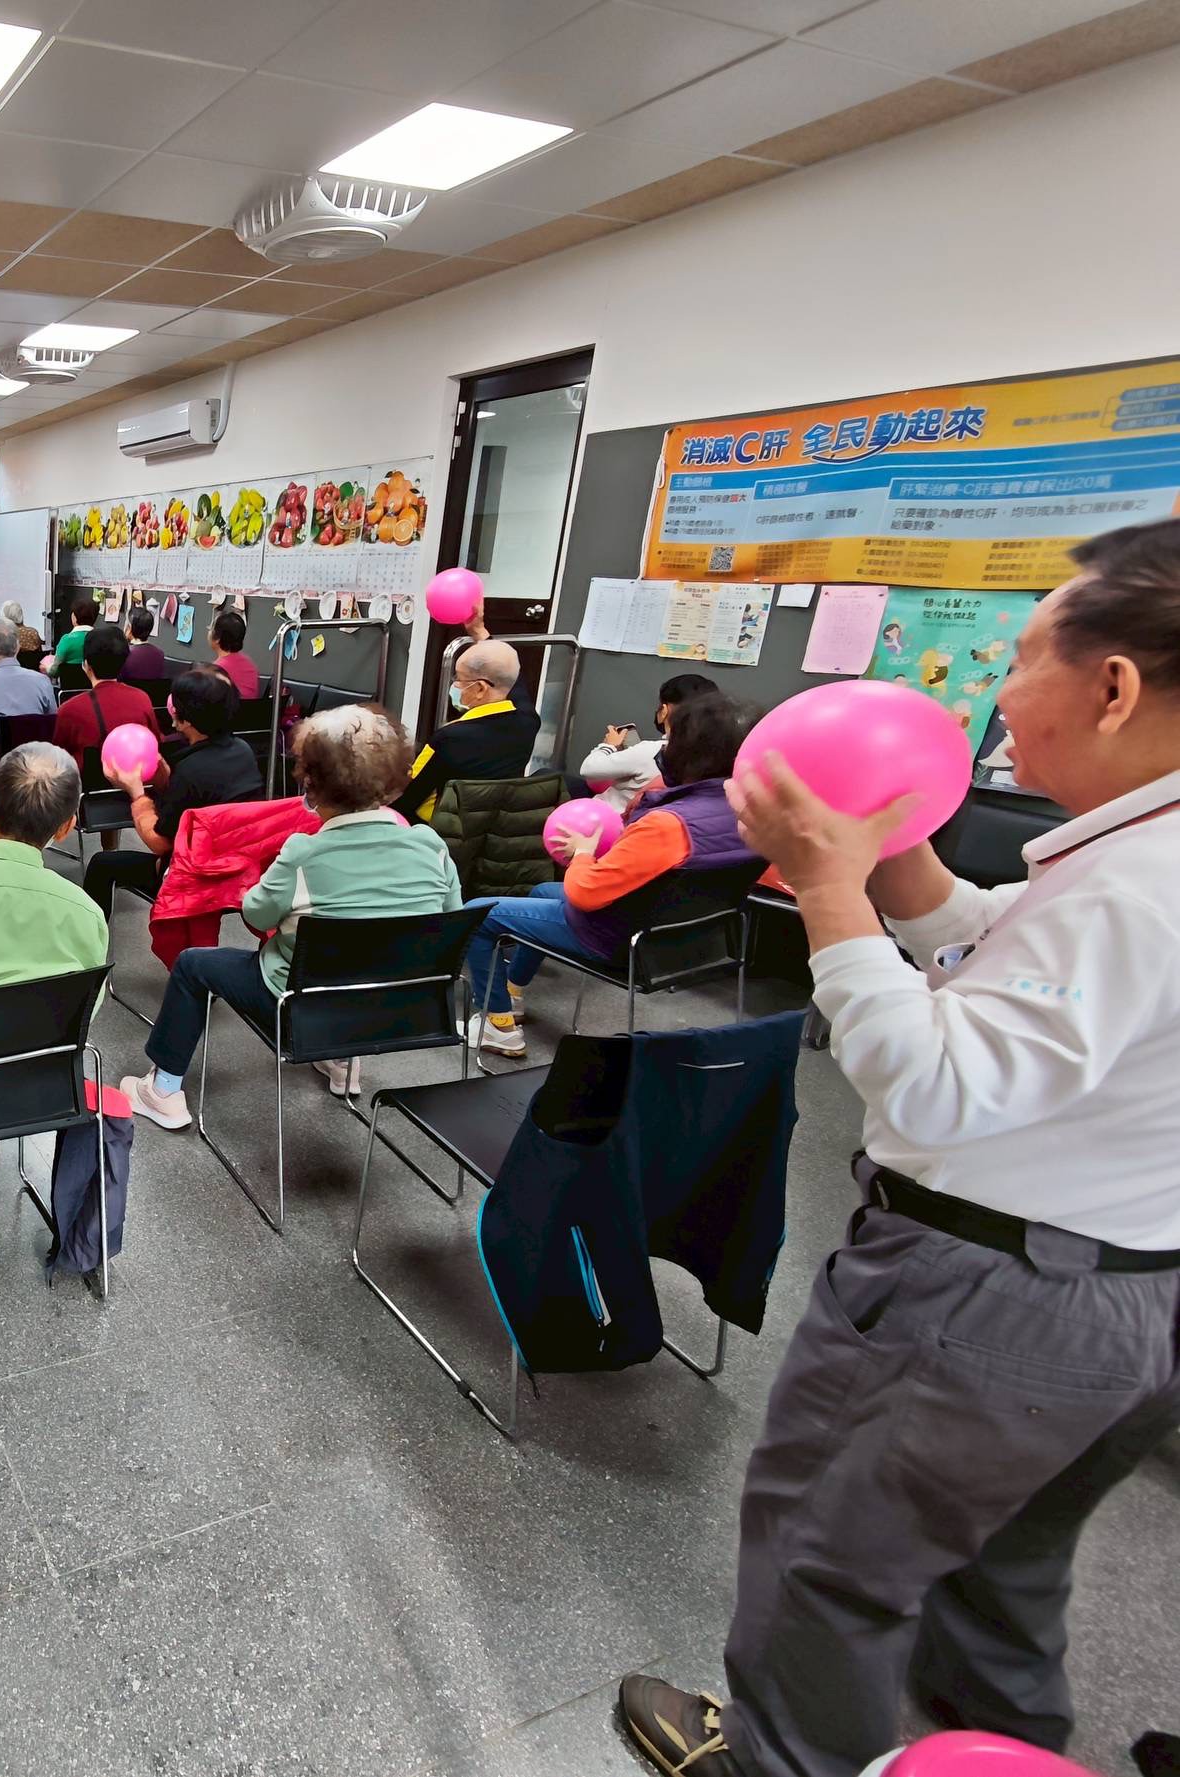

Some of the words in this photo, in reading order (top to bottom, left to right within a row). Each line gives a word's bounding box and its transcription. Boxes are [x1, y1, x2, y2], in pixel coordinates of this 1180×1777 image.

[680, 428, 791, 466] 消滅C肝
[801, 406, 987, 461] 全民動起來
